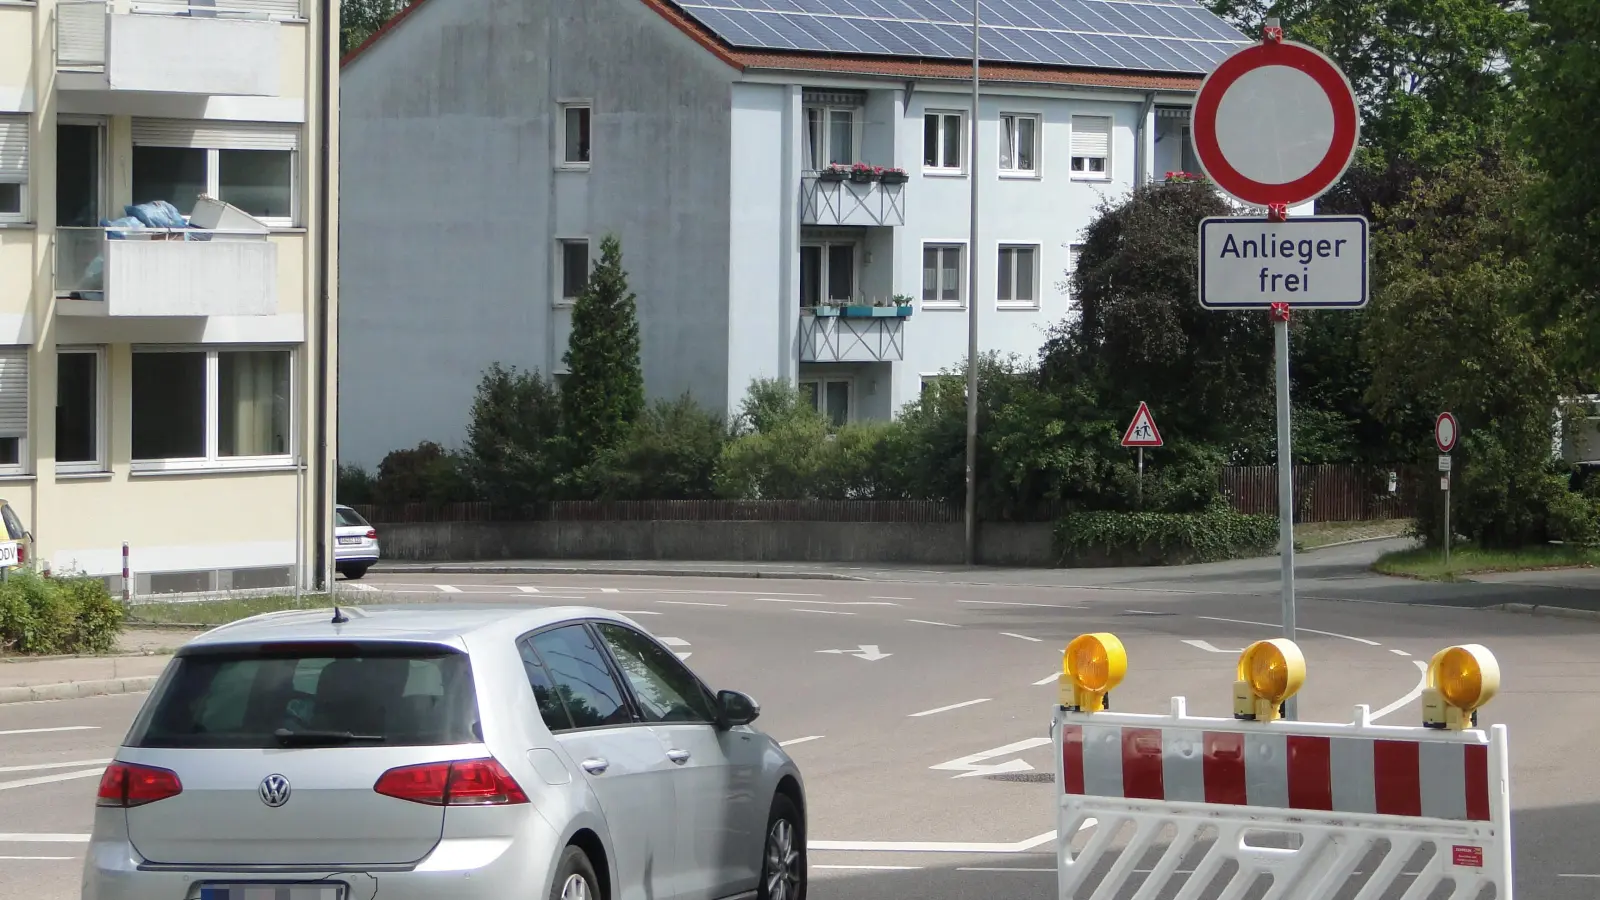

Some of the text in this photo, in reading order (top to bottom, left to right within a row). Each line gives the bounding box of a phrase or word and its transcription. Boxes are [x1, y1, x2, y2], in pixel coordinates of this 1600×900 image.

[1219, 233, 1347, 265] Anlieger
[1259, 267, 1308, 292] frei
[260, 775, 290, 806] VW
